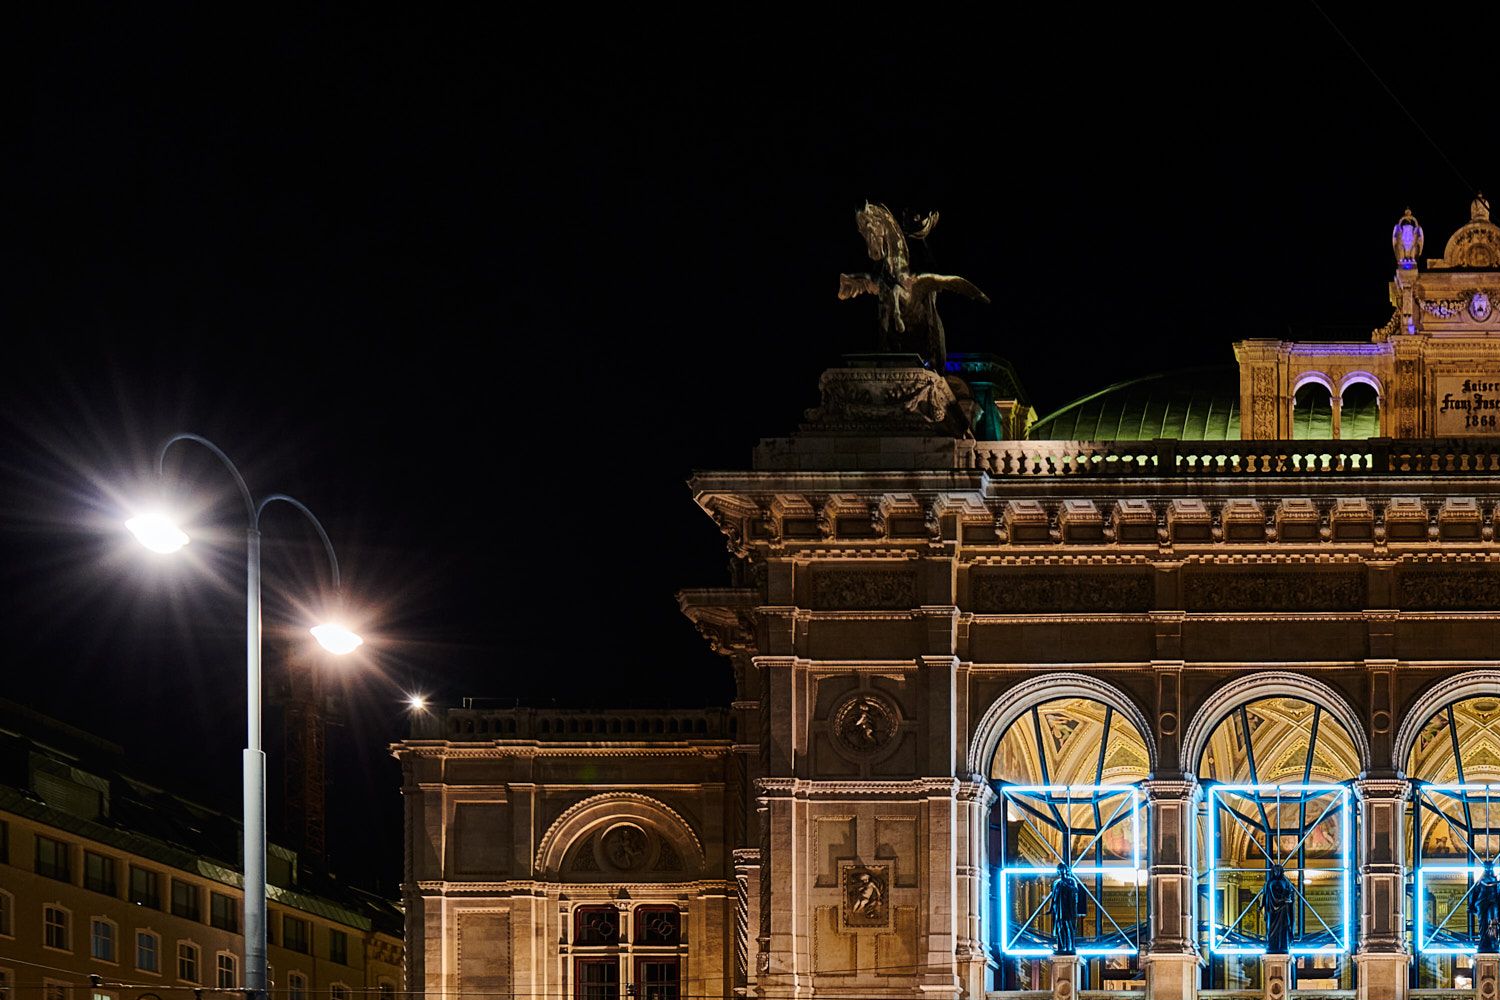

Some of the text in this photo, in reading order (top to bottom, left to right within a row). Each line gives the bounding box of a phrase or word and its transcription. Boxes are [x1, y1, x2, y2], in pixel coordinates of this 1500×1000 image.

[1462, 380, 1500, 393] Kaiser
[1440, 393, 1472, 414] Franz
[1465, 415, 1496, 428] 1868
